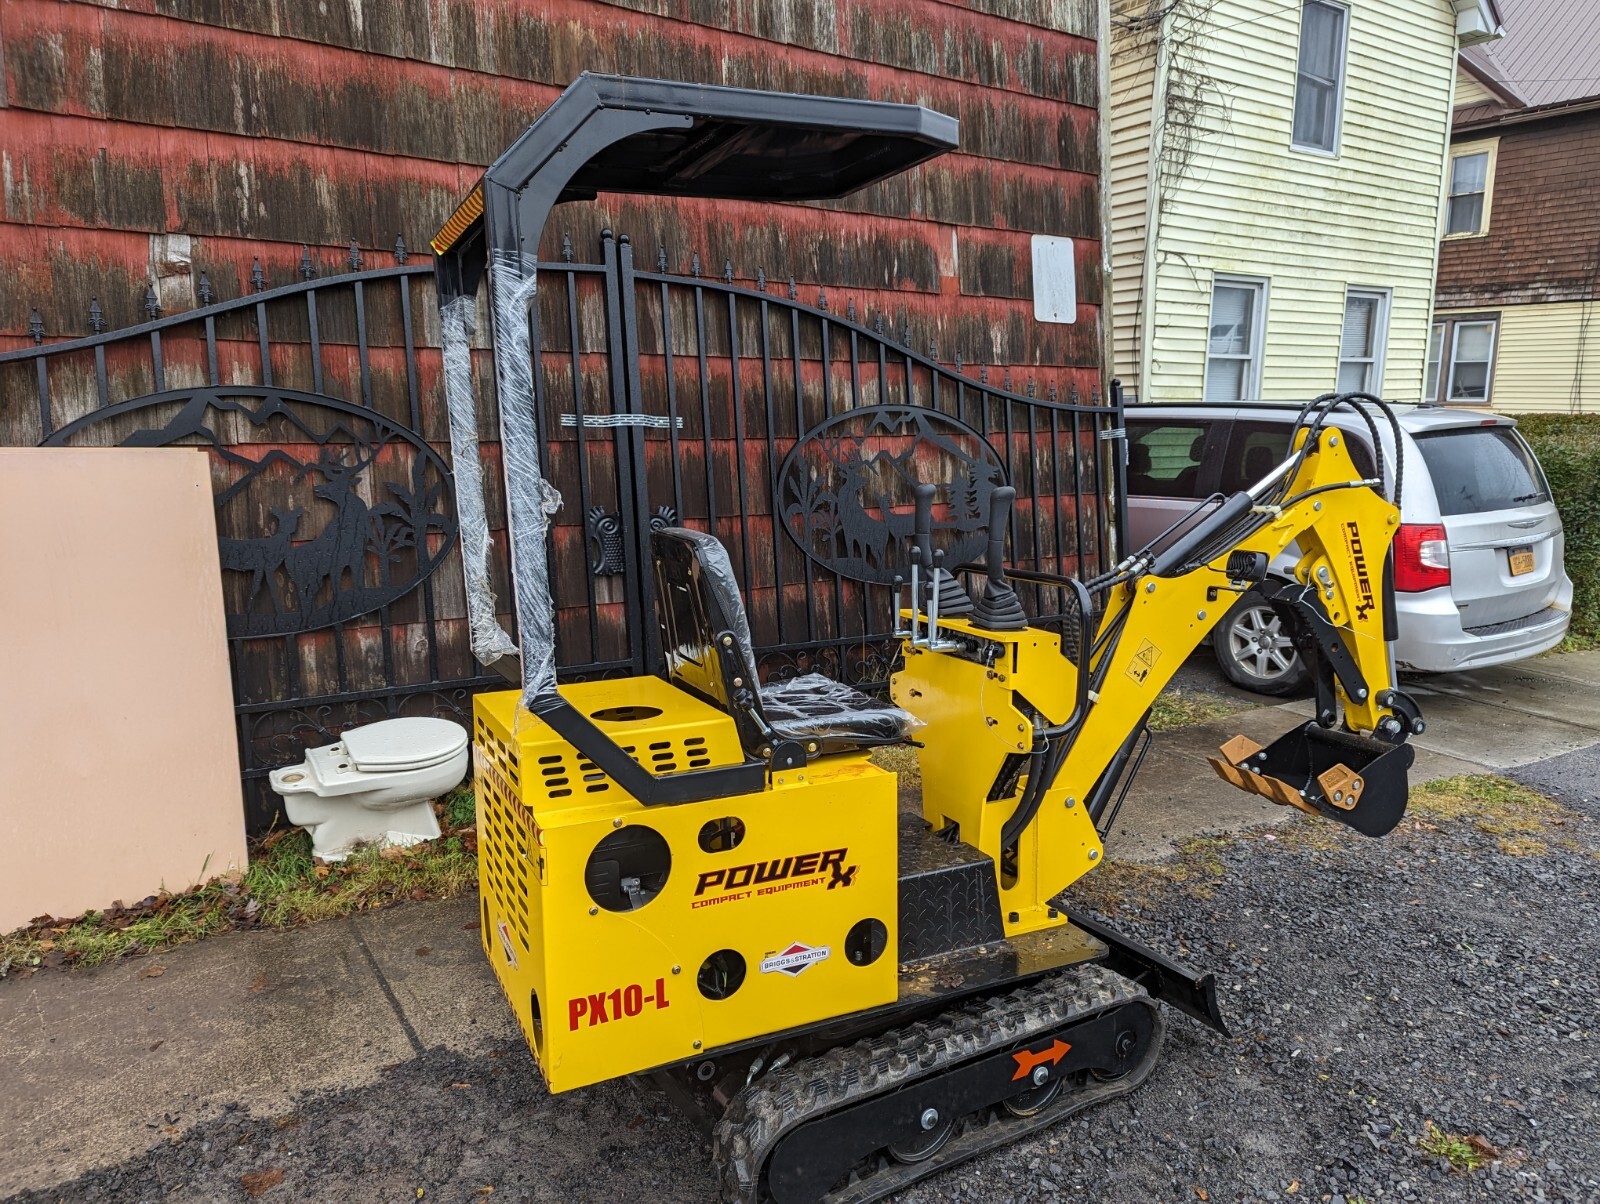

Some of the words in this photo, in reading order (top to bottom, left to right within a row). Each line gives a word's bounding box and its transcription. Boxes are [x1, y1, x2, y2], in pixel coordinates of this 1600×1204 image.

[691, 891, 752, 909] COMPACT
[757, 877, 826, 896] EQUIPMENT
[568, 978, 670, 1032] PX10-L
